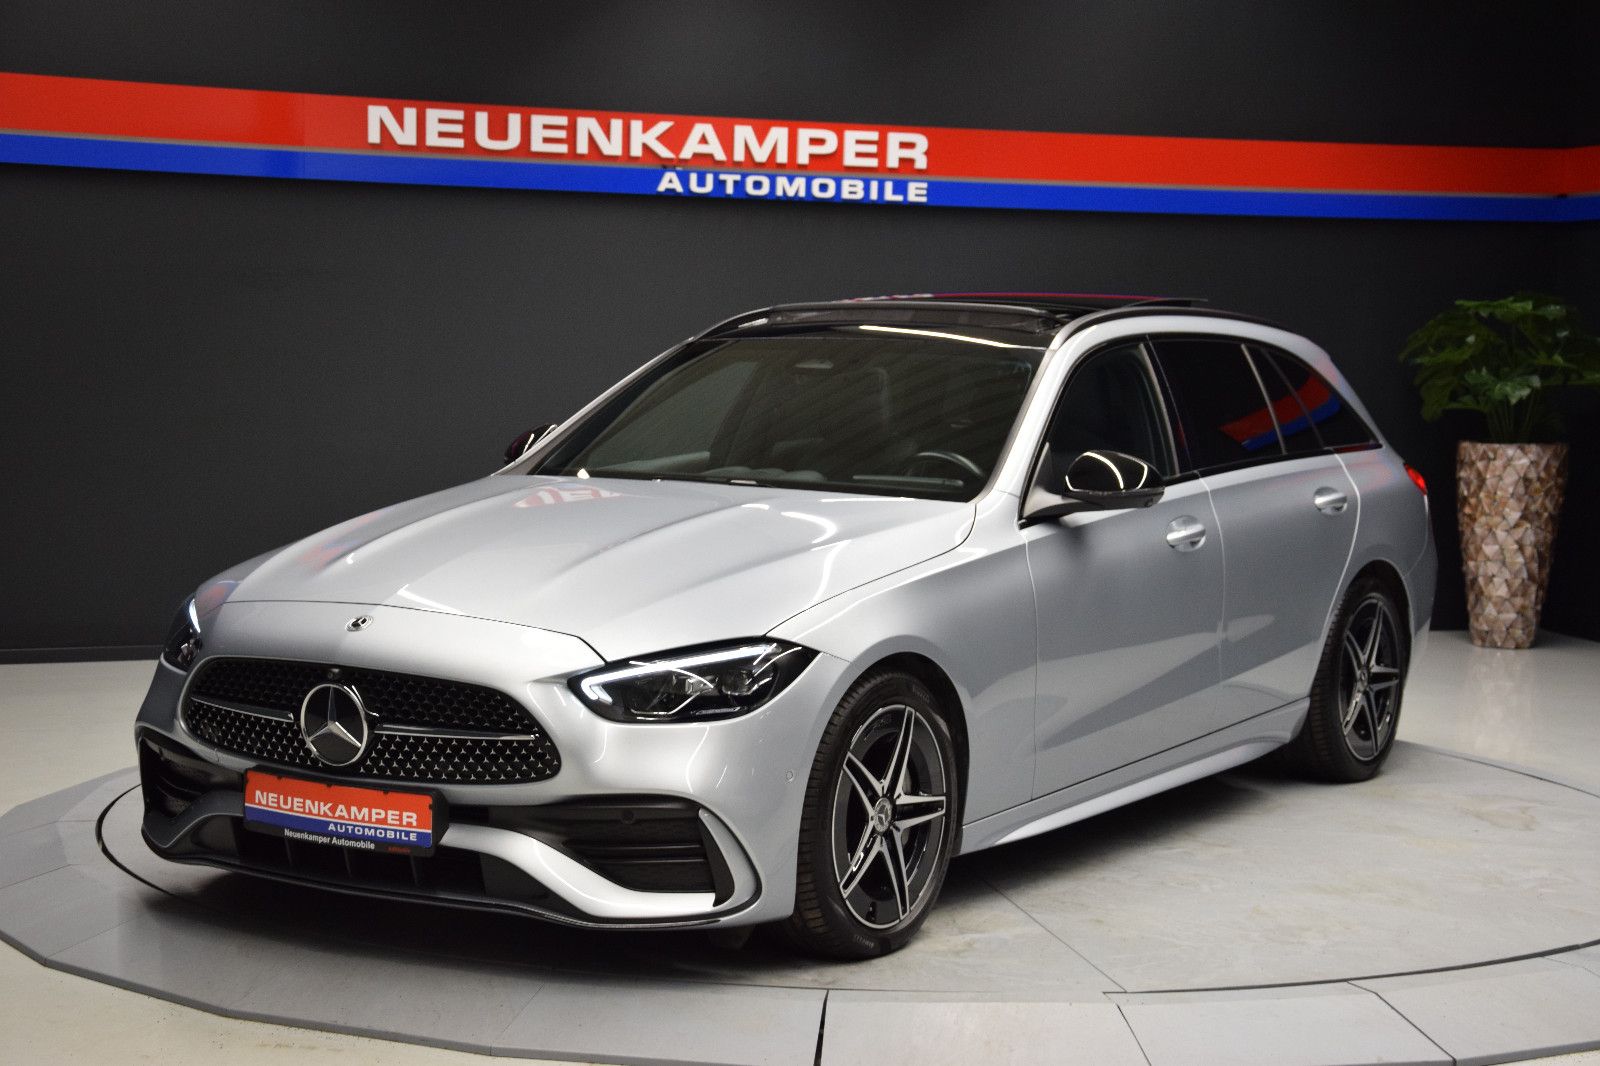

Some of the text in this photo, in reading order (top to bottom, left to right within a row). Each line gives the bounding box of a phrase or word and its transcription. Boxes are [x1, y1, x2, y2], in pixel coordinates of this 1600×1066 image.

[366, 104, 929, 170] NEUENKAMPER
[656, 170, 929, 203] AUTOMOBILE
[254, 789, 418, 827] NEUENKAMPER
[284, 828, 331, 844] Neuenkamper
[331, 835, 376, 850] Automobile
[327, 822, 418, 842] AUTOMOBILE
